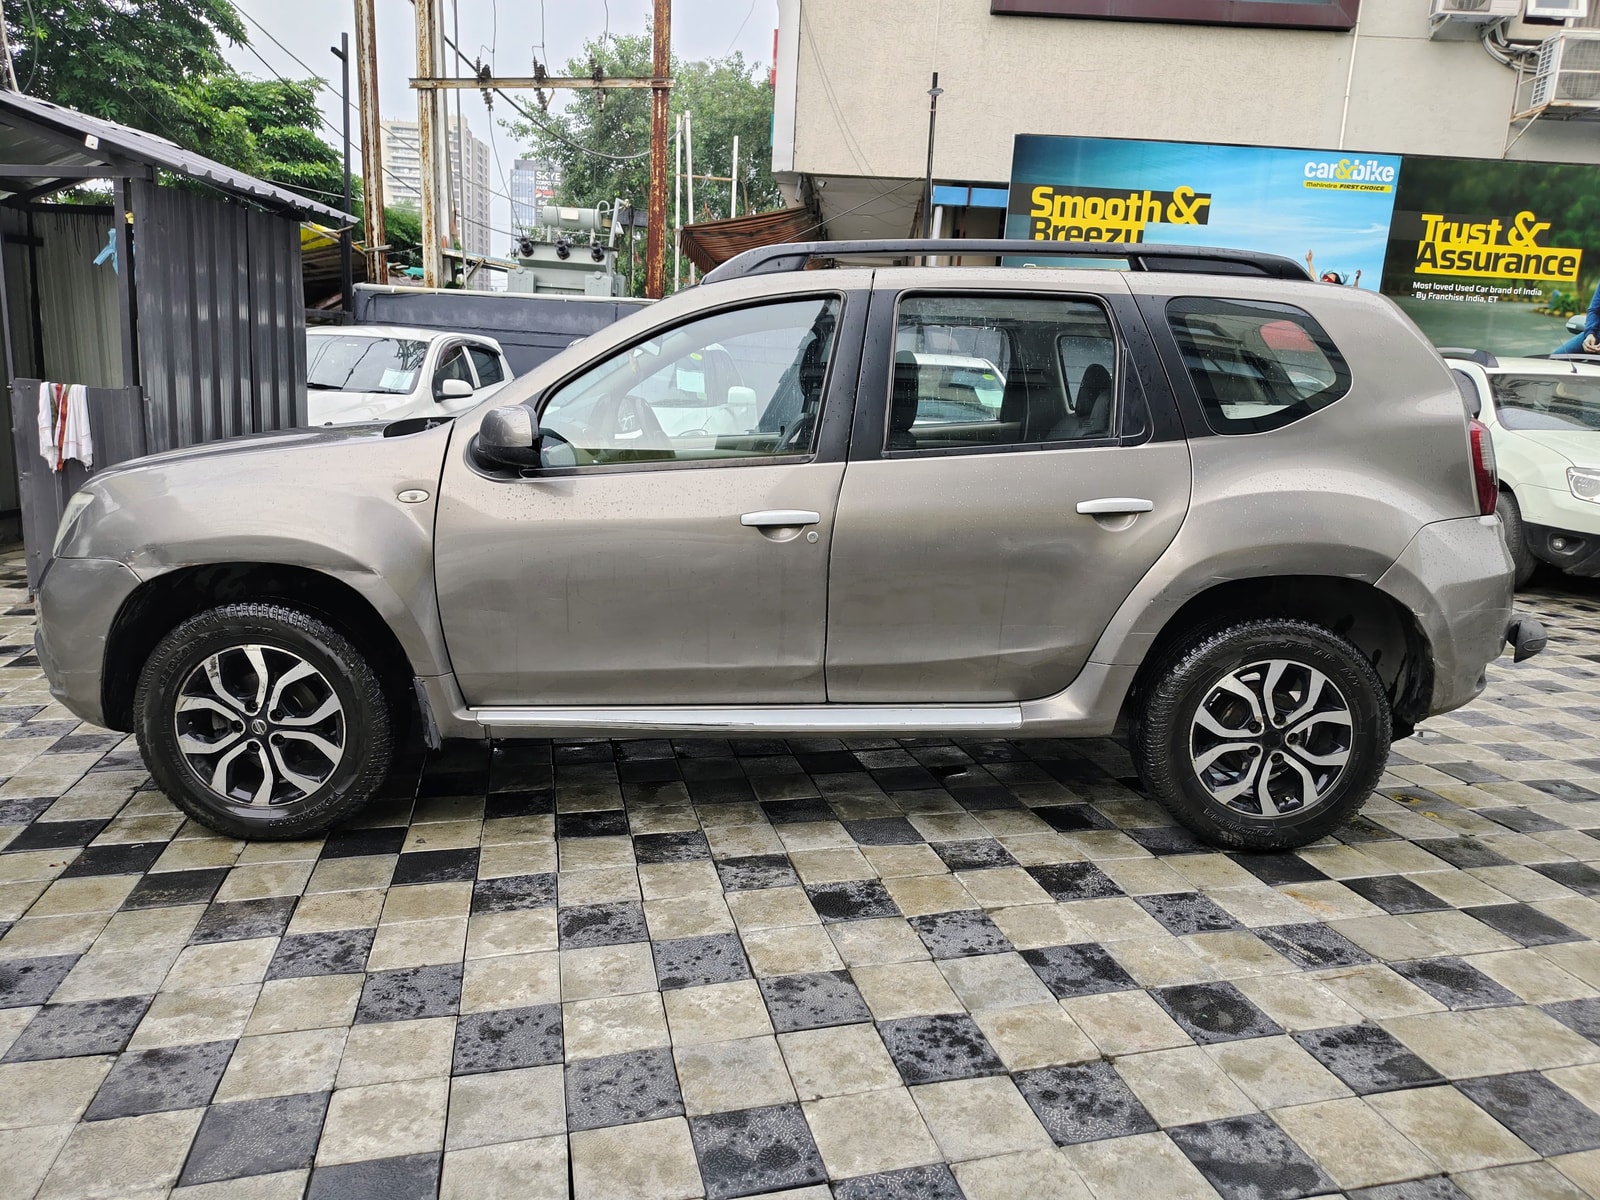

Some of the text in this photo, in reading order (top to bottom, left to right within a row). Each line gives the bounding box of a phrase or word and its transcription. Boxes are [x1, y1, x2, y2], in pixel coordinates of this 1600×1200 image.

[536, 171, 561, 180] SKYE
[1030, 185, 1212, 225] Smooth &
[1421, 210, 1552, 247] Trust &
[1416, 241, 1577, 277] Assurance
[1412, 281, 1543, 296] Most loved Used Car brand of India
[1416, 291, 1427, 300] By
[1428, 292, 1464, 302] Franchise
[1465, 294, 1487, 304] India,
[1487, 295, 1499, 303] ET
